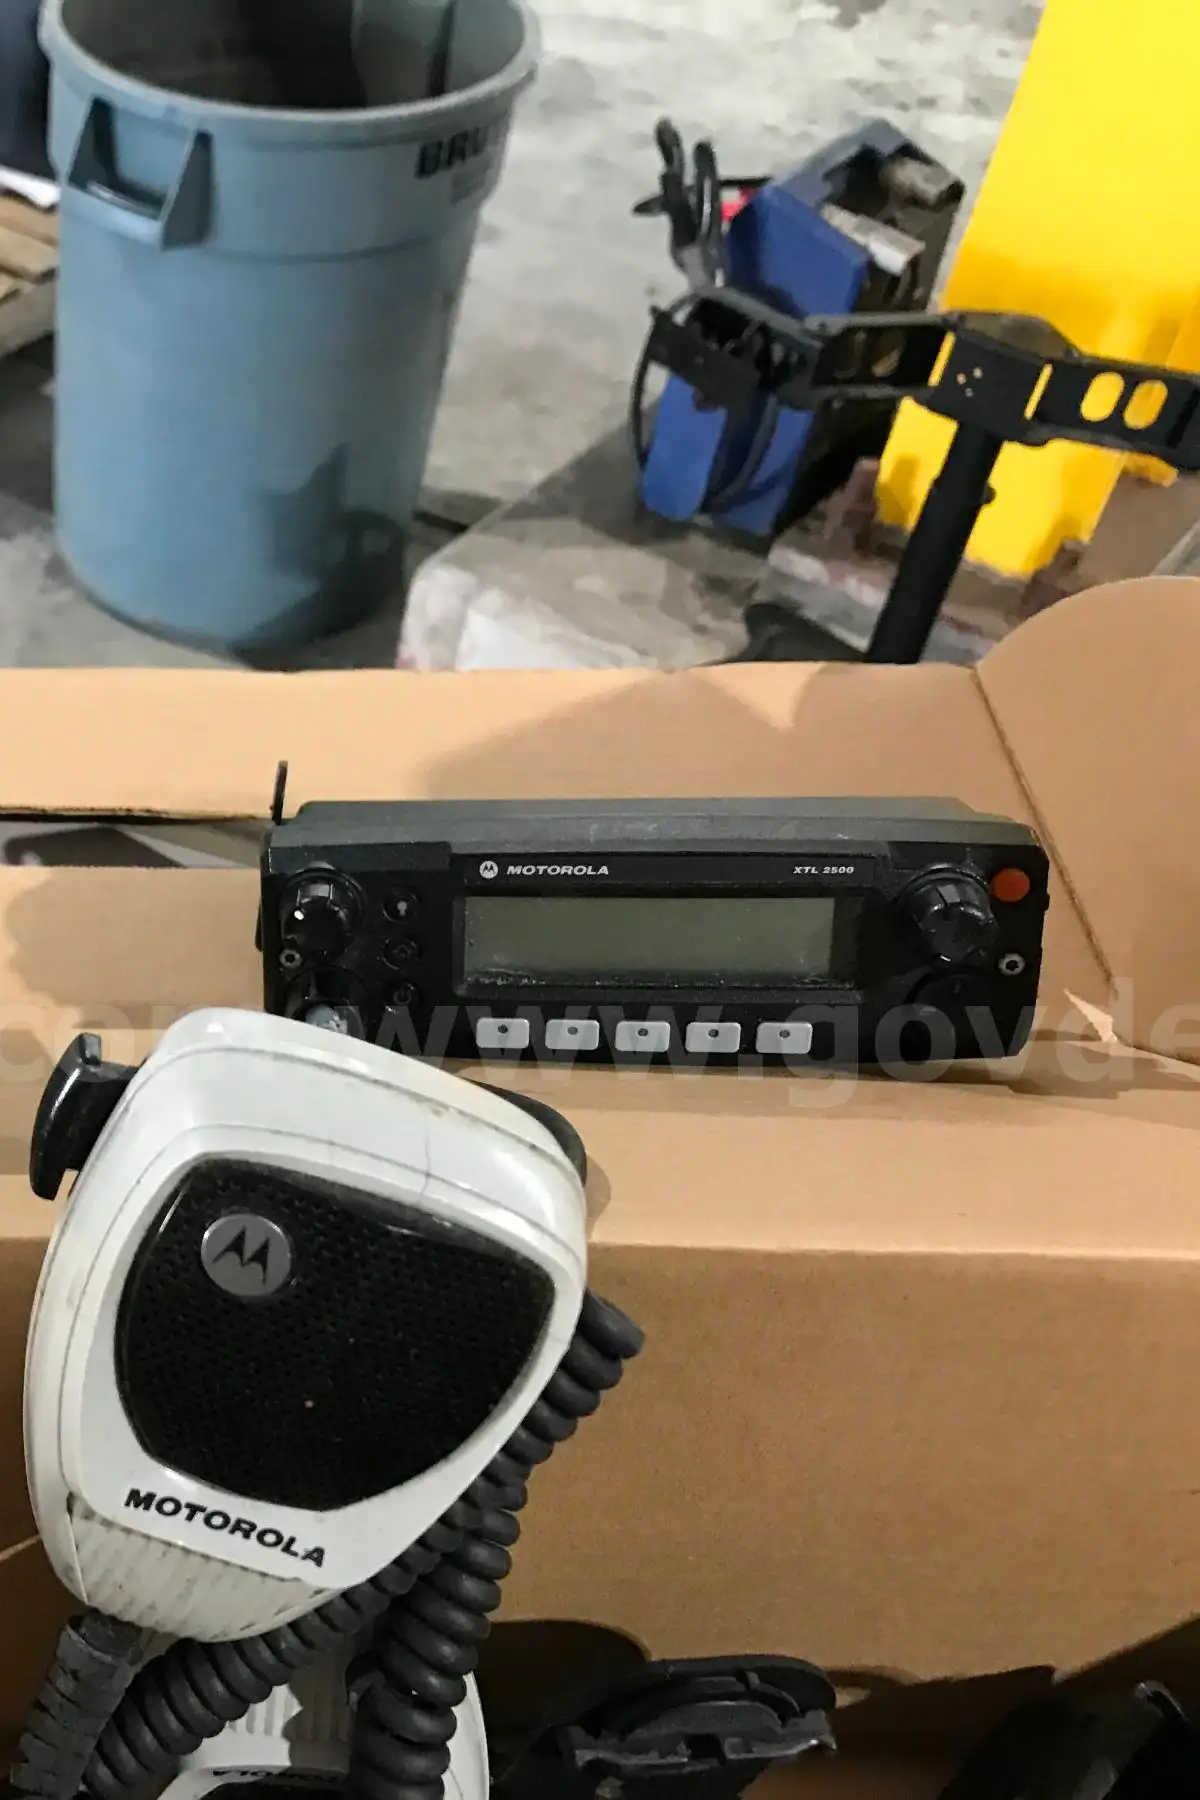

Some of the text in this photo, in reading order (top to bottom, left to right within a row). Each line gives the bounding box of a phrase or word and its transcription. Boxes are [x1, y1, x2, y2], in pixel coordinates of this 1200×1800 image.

[506, 864, 609, 876] MOTOROLA
[793, 866, 855, 875] XTL 2500
[124, 1488, 326, 1568] MOTOROLA
